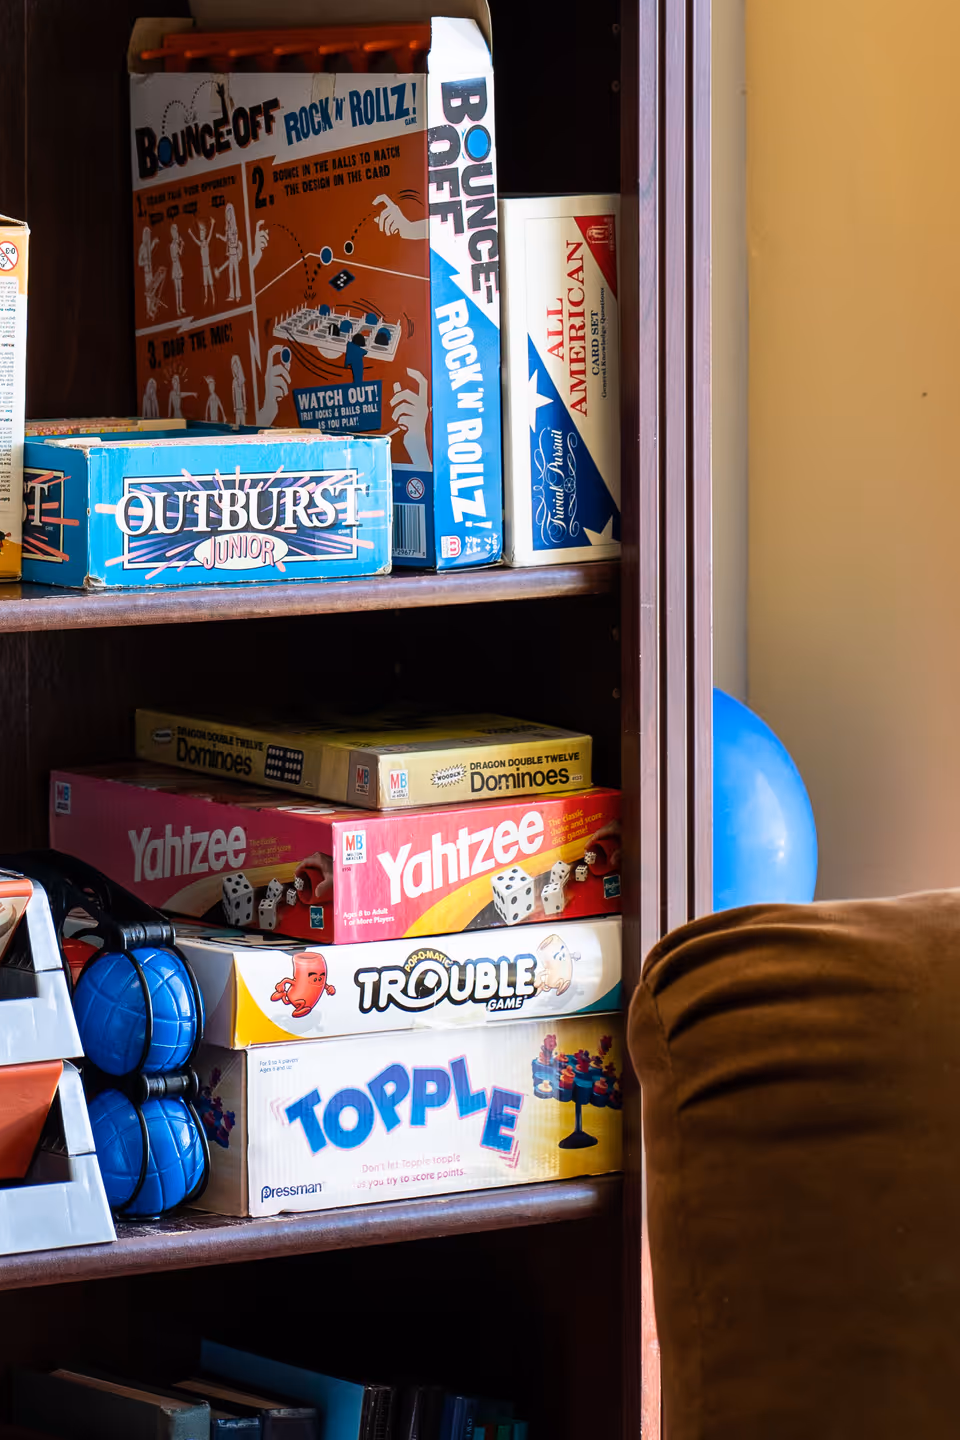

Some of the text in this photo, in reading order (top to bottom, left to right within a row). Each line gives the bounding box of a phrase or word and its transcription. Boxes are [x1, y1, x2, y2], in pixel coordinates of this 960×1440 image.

[284, 96, 332, 146] ROCK
[272, 165, 300, 183] BOUNCE
[302, 163, 311, 176] IN
[314, 160, 329, 173] THE
[332, 155, 357, 170] BALLS
[359, 151, 371, 164] TO
[373, 145, 401, 161] MATCH
[283, 183, 300, 197] THE
[302, 176, 331, 193] DESIGN
[347, 170, 363, 184] THE
[365, 165, 391, 180] CARD
[427, 124, 464, 236] OFF
[546, 296, 565, 362] ALL
[565, 239, 588, 418] AMERICAN
[434, 298, 479, 386] ROCK
[590, 309, 601, 377] CARD SET
[297, 384, 379, 411] WATCH OUT!
[300, 411, 314, 421] TRAY
[315, 409, 333, 420] ROCKS
[340, 406, 361, 417] BALLS
[362, 403, 378, 414] ROLL
[318, 416, 360, 429] AS YOU PLAY!
[544, 428, 566, 485] Pursuit
[446, 418, 493, 530] ROLLZ!
[114, 482, 369, 538] OUTBURST
[202, 534, 277, 570] JUNIOR
[465, 536, 473, 555] 2-4
[483, 536, 492, 551] 7+
[235, 737, 263, 751] TWELVE
[176, 738, 252, 776] Dominoes
[469, 752, 580, 771] DRAGON DOUBLE TWELVE
[356, 768, 369, 785] MB
[390, 772, 408, 790] MB
[470, 768, 570, 793] Dominoes
[56, 783, 71, 801] MB
[548, 809, 584, 827] The classic
[549, 825, 570, 837] shake
[571, 820, 584, 830] and
[345, 834, 363, 852] MB
[551, 826, 589, 845] dice game!
[128, 824, 247, 883] Yahtzee
[377, 811, 545, 906] Yahtzee
[343, 910, 355, 919] Ages
[372, 907, 388, 916] Adult
[356, 917, 372, 925] More
[373, 915, 395, 925] Players
[404, 950, 453, 973] POP-O-MATIC
[355, 956, 537, 1013] TROUBLE
[487, 998, 524, 1011] GAME
[282, 1058, 299, 1066] players
[284, 1054, 525, 1157] TOPPLE
[361, 1153, 461, 1174] Don't let Topple topple
[356, 1167, 467, 1190] as you try to score points.
